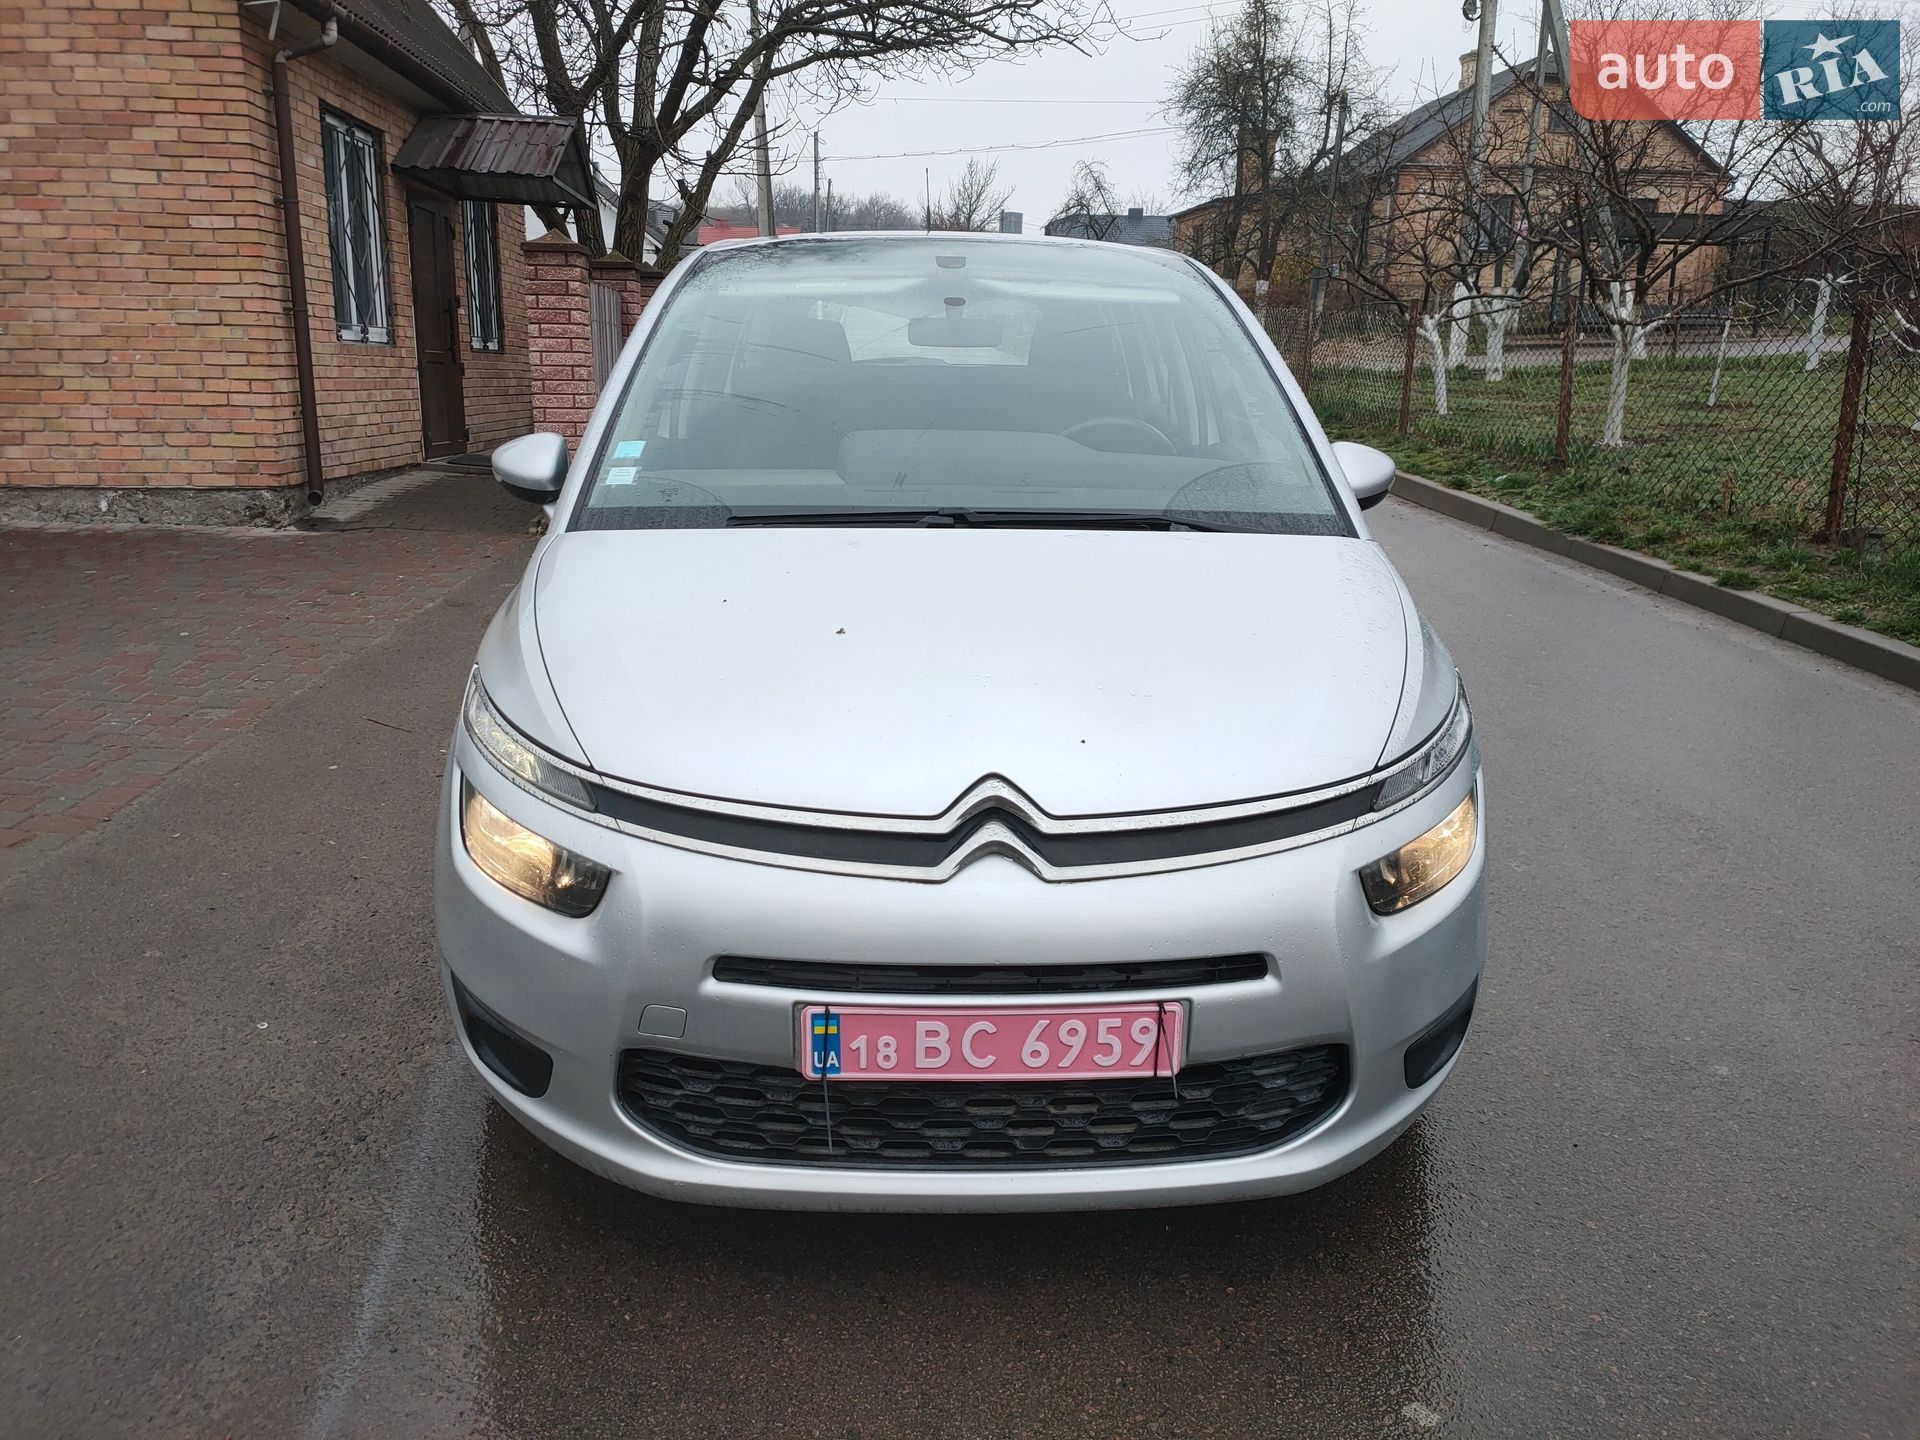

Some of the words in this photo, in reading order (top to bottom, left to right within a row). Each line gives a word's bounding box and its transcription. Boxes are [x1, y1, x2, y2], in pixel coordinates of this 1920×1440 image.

[813, 1050, 840, 1068] UA
[849, 1035, 898, 1070] 18
[914, 1020, 998, 1069] BC
[1020, 1017, 1160, 1069] 6959
